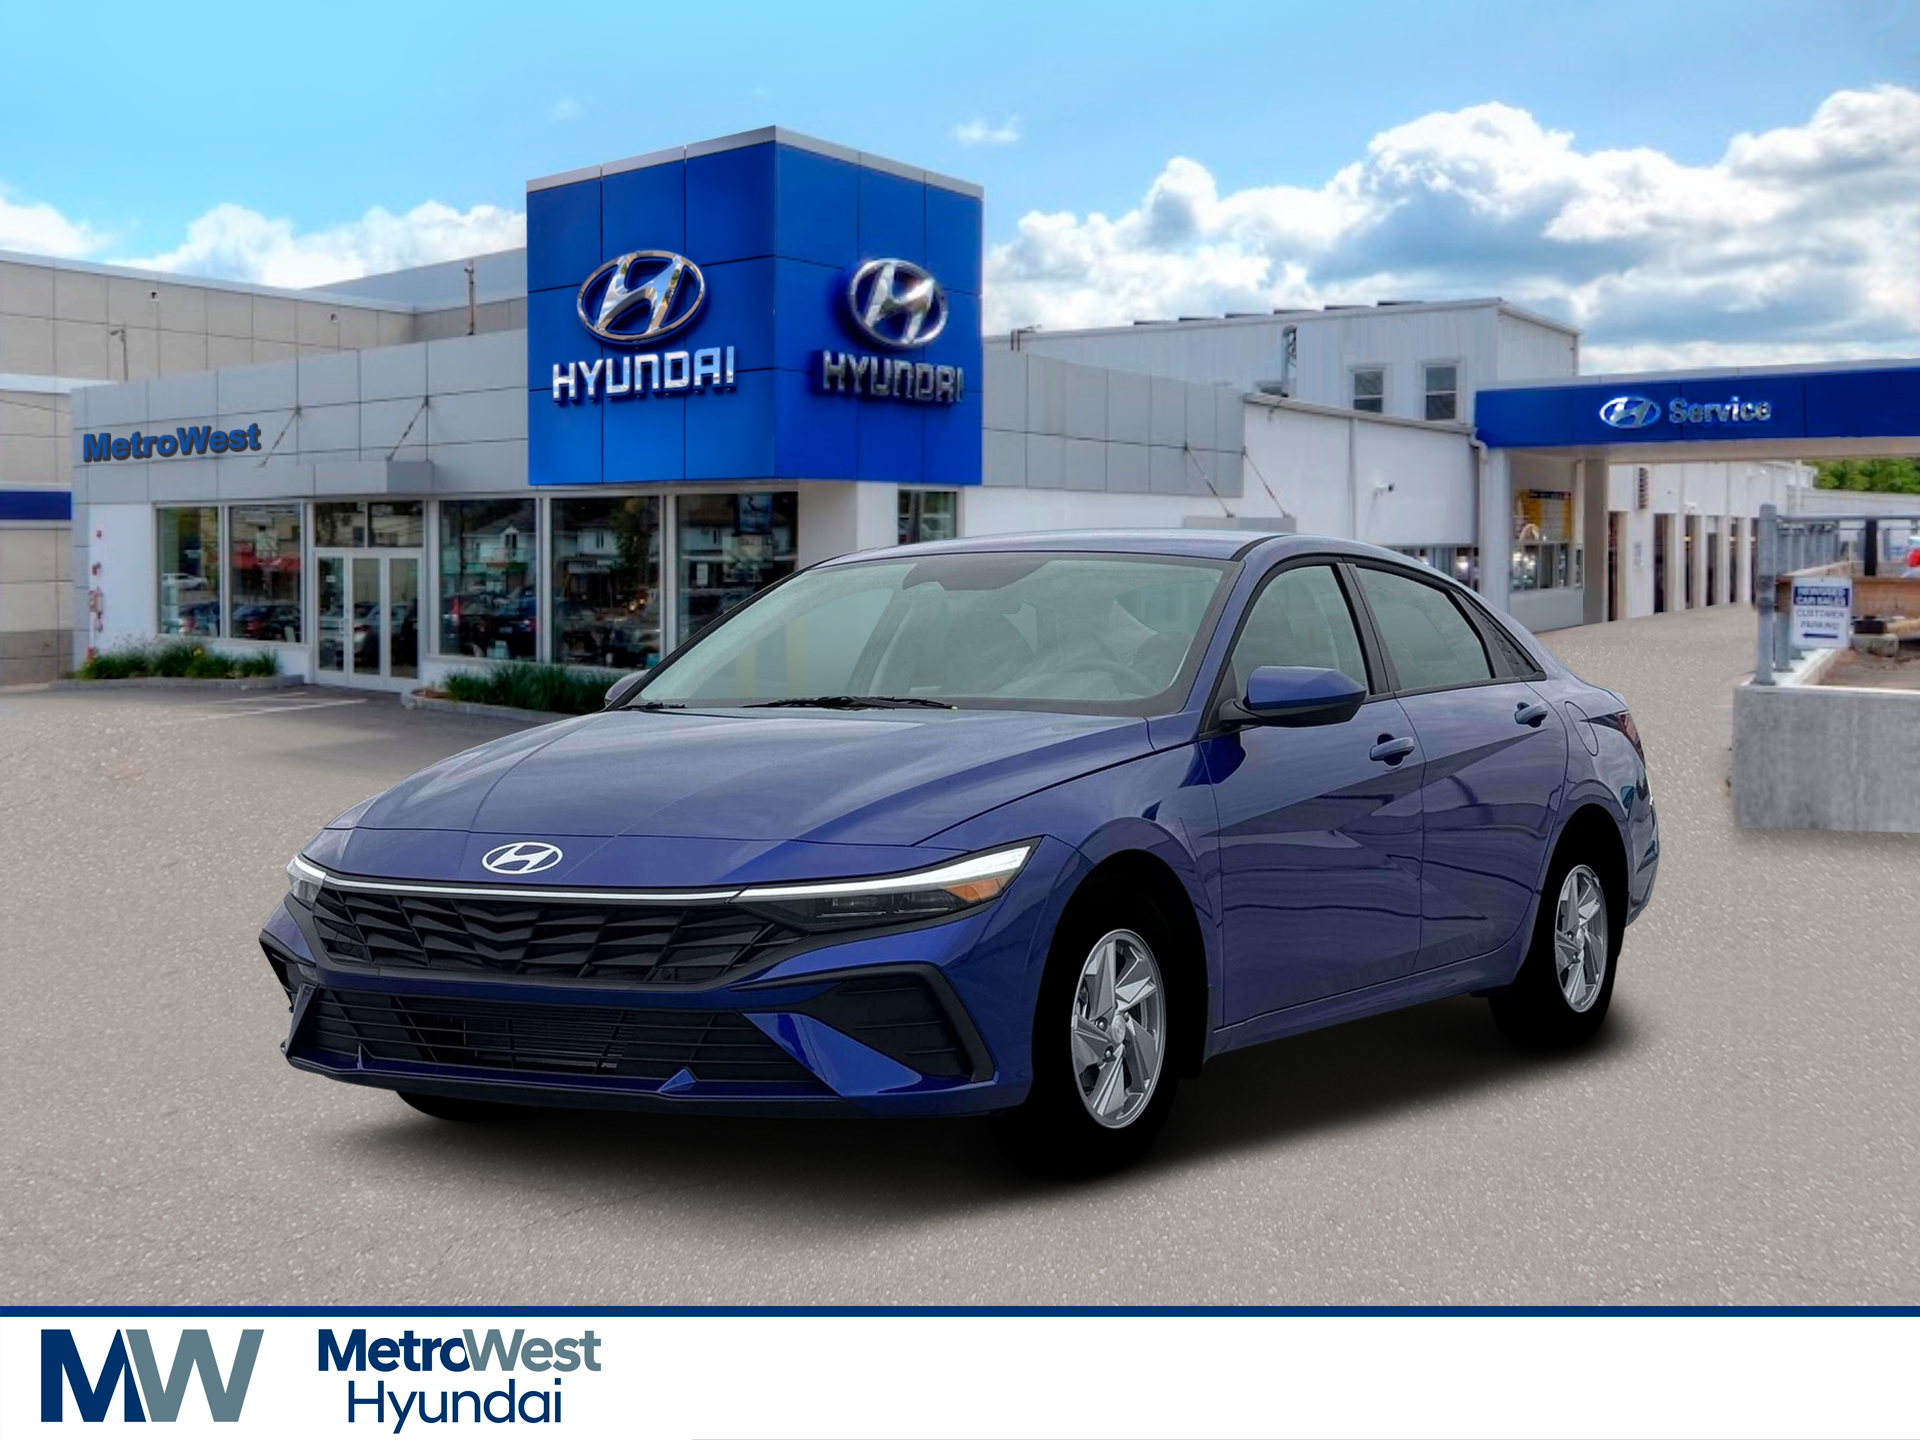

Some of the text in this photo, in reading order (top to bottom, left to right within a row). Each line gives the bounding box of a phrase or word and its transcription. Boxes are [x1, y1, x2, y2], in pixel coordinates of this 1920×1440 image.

[553, 346, 736, 404] HYUNDAI
[822, 350, 964, 403] HYUNDAI
[1669, 396, 1772, 424] Service
[83, 423, 262, 463] MetroWest
